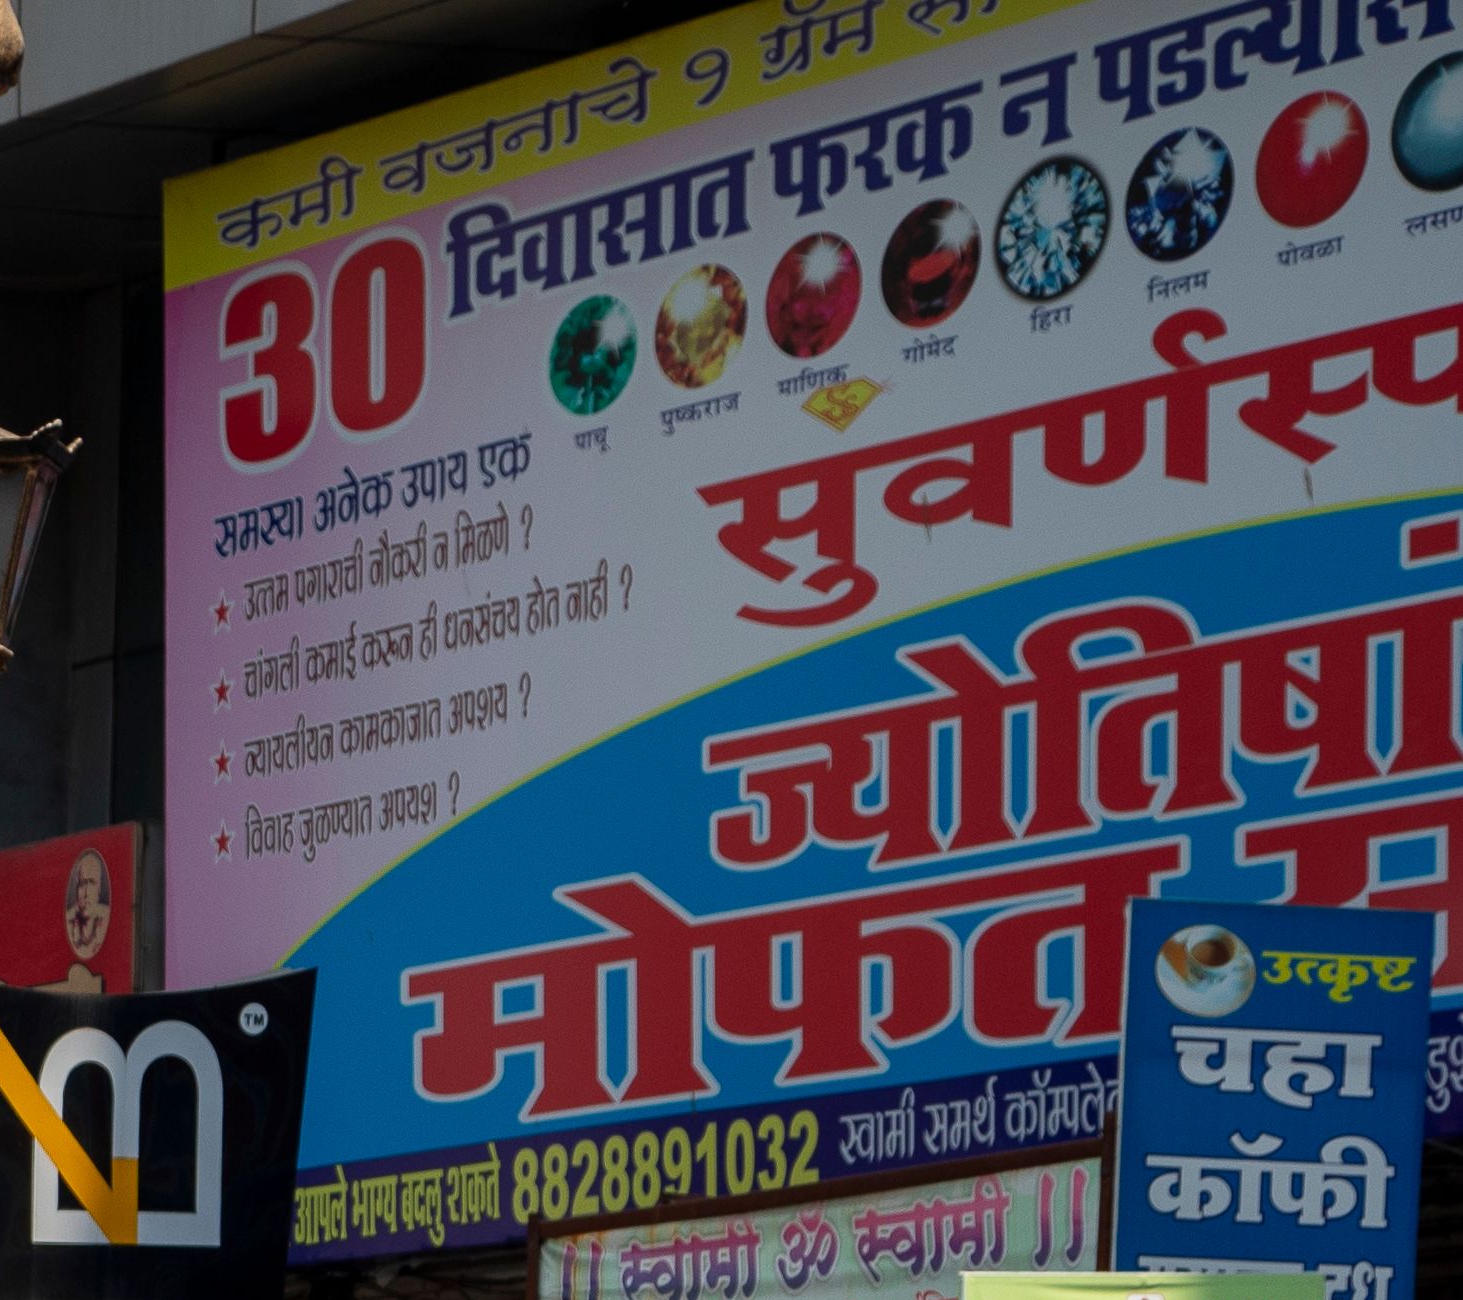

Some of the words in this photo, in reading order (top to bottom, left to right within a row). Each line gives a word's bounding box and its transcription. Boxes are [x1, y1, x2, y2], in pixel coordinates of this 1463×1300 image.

[217, 156, 363, 250] कमी
[381, 57, 658, 195] वजनाचे
[223, 238, 426, 464] 30
[448, 200, 755, 318] दिवासात
[770, 81, 984, 218] फरक
[1000, 50, 1079, 147] न
[1147, 270, 1212, 301] निलम
[1277, 235, 1345, 267] पोवळा
[903, 334, 958, 363] गोमेद
[1030, 305, 1073, 333] हिरा
[661, 391, 742, 436] पुष्कराज
[777, 364, 850, 397] माणिक
[214, 494, 304, 558] समस्या
[314, 467, 394, 534] अनेक
[401, 449, 468, 509] उपाय
[295, 537, 363, 604] पगाराची
[433, 532, 449, 572] न
[454, 502, 511, 568] मिळणे
[244, 635, 300, 701] चांगली
[306, 621, 357, 684] कमाई
[419, 600, 438, 660] ही
[526, 576, 559, 634] होत
[566, 558, 609, 624] नाही
[245, 804, 294, 860] विवाह
[404, 842, 1184, 1118] मोफत
[1262, 950, 1417, 1002] उत्कृष्ट
[1170, 1024, 1383, 1109] चहा
[294, 1164, 349, 1248] आपले
[352, 1175, 398, 1237] भाग्य
[447, 1141, 503, 1226] शकते
[511, 1109, 821, 1219] 8828891032
[837, 1090, 915, 1166] स्वामी
[923, 1077, 999, 1155] समर्थ
[1145, 1131, 1396, 1229] कॉफी
[776, 1210, 839, 1291] ॐ
[853, 1176, 1011, 1283] स्वामी
